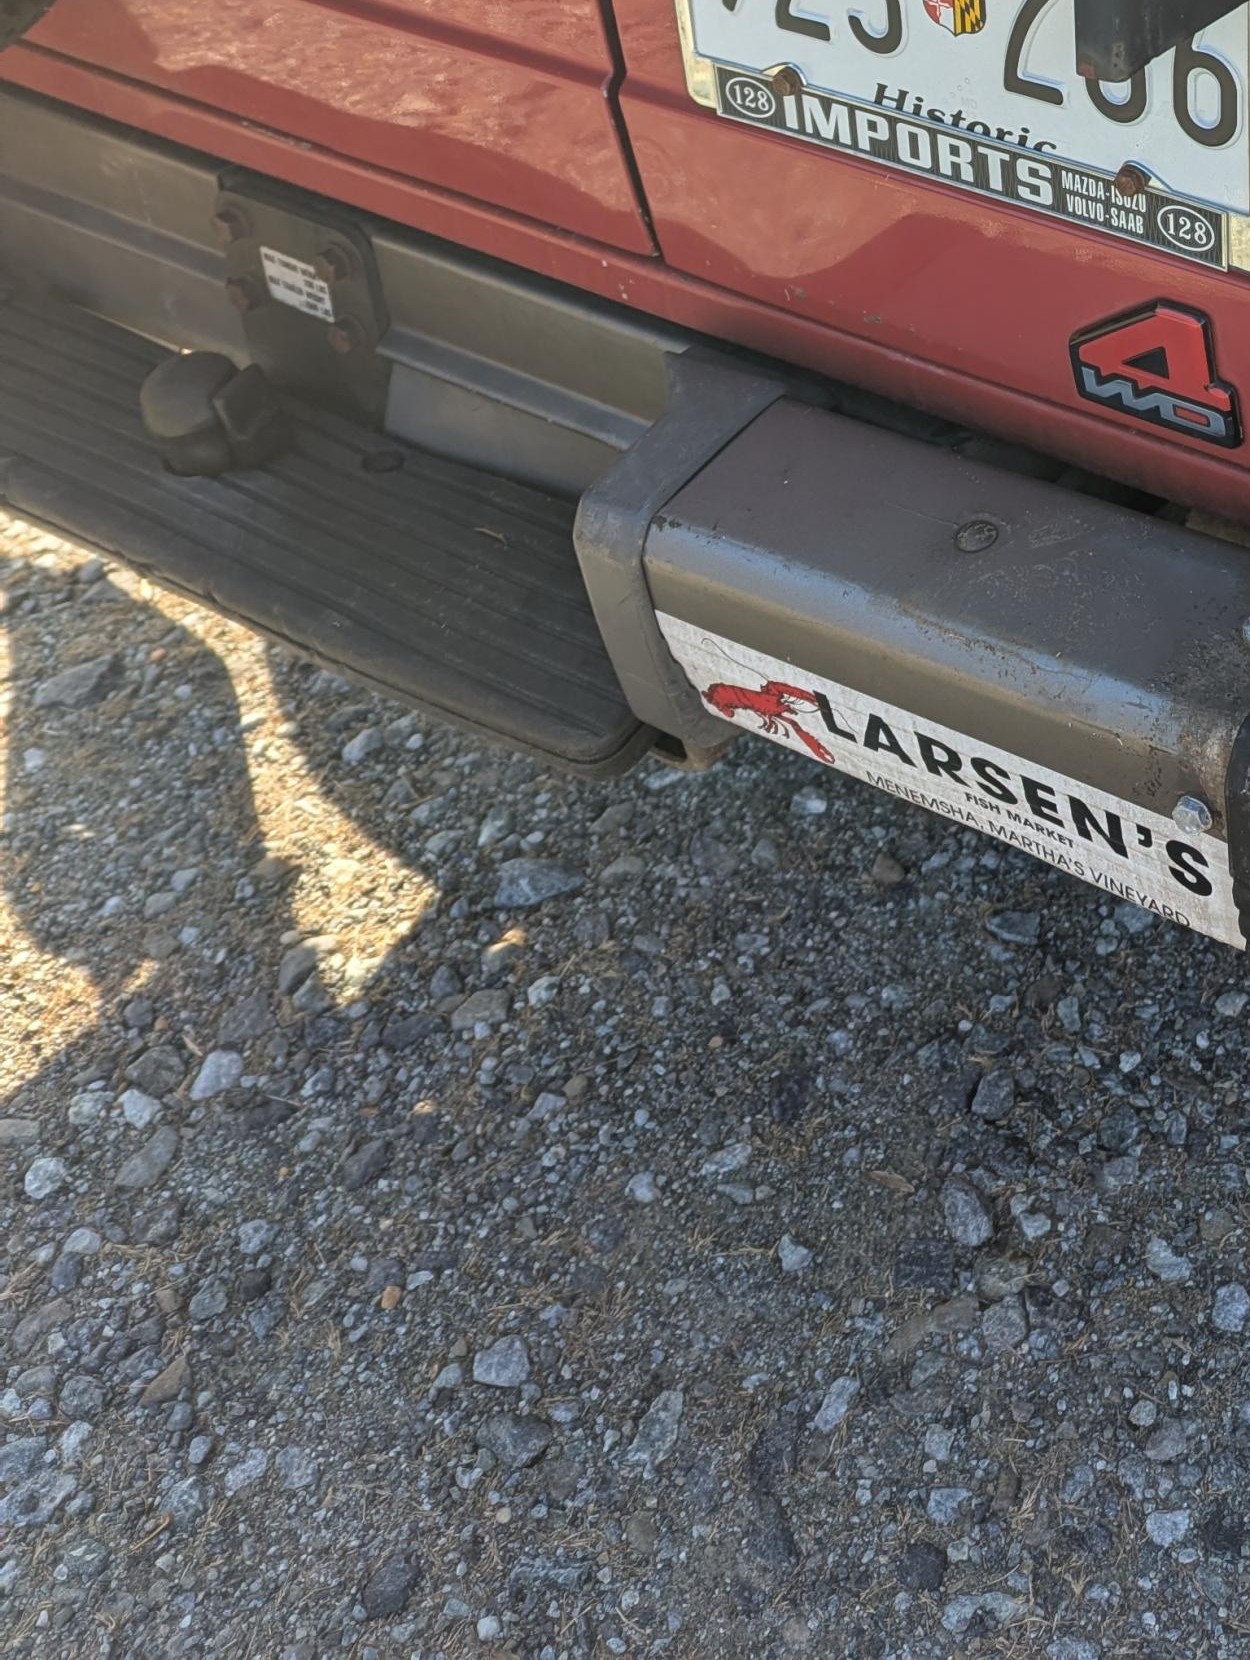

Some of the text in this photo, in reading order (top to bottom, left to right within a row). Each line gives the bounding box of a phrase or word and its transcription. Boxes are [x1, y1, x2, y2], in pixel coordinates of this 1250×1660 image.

[733, 84, 770, 112] 128
[782, 93, 1053, 207] IMPORTS
[873, 82, 1057, 153] Historic
[1066, 193, 1207, 245] VOLVO-SAAB 128
[813, 690, 1213, 897] LARSEN'S
[965, 791, 1075, 849] FISH MARKET
[866, 770, 1191, 927] MENEMSHA, MARTHA'S VINEYARD
